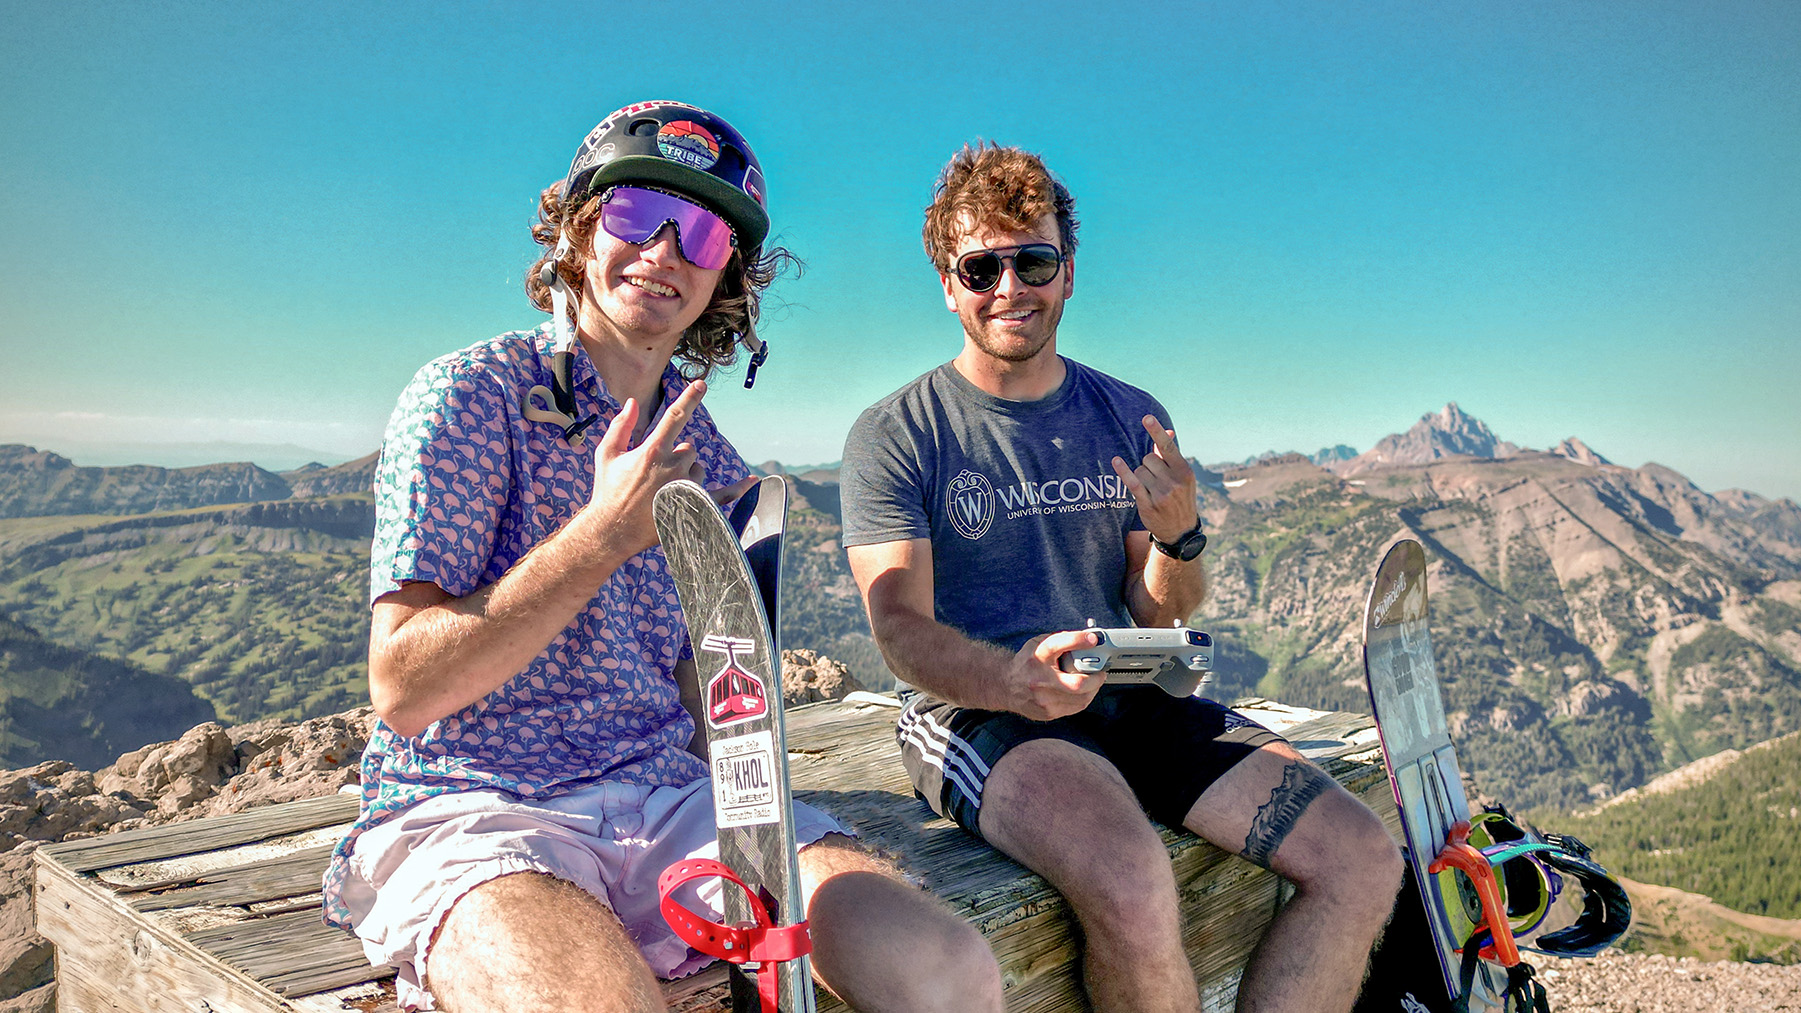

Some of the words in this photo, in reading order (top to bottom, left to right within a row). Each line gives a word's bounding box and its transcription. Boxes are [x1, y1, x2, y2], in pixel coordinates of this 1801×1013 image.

[666, 145, 704, 166] TRIBE
[957, 492, 983, 526] W
[1043, 506, 1056, 515] OF
[733, 758, 769, 791] KHOL
